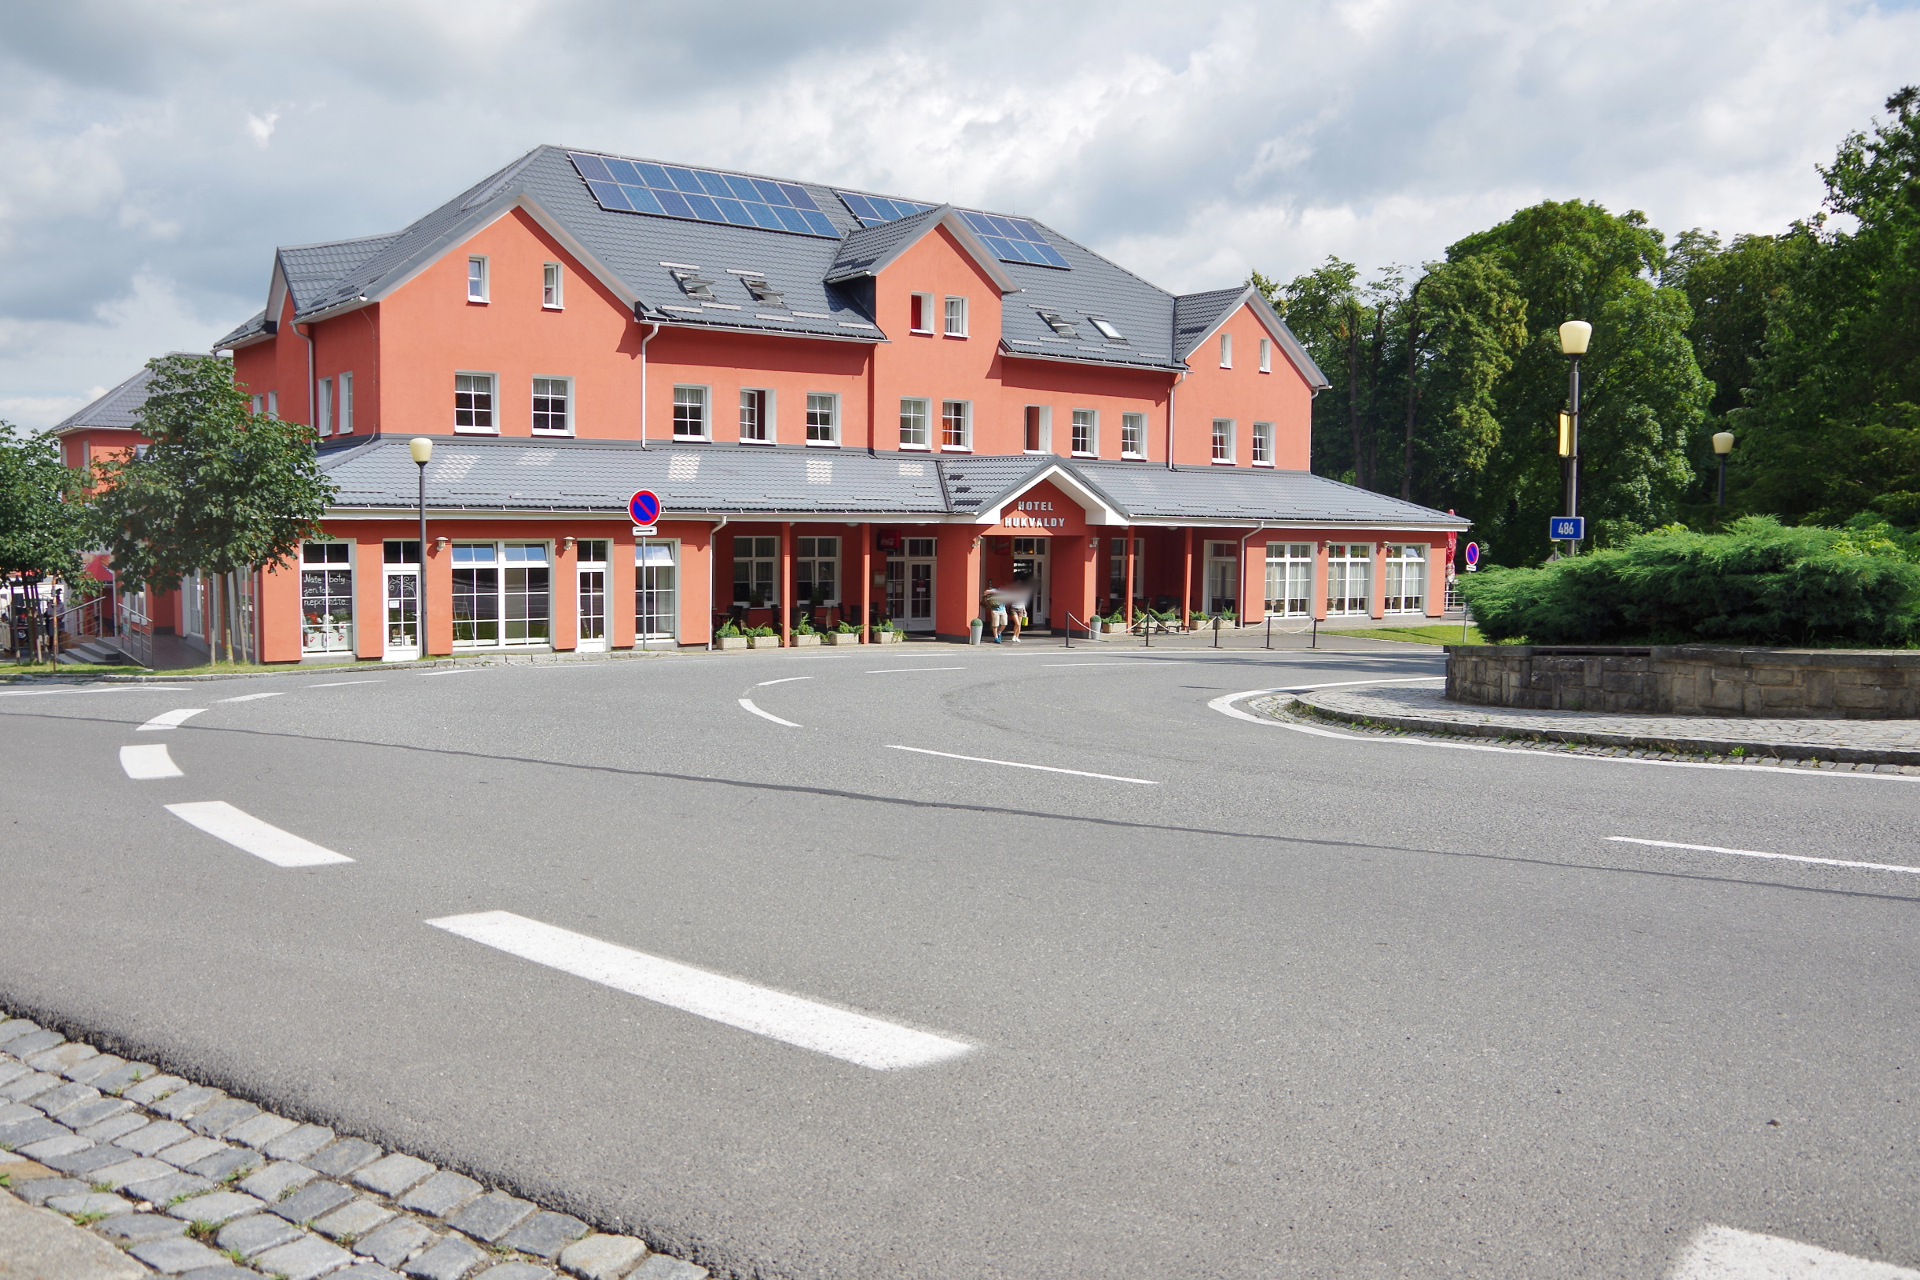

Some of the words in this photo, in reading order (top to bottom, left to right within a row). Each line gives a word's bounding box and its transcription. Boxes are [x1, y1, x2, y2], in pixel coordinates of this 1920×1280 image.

[1018, 501, 1054, 511] HOTEL
[1004, 517, 1065, 528] HUKVALDY
[1558, 522, 1574, 535] 486
[329, 573, 345, 585] boty
